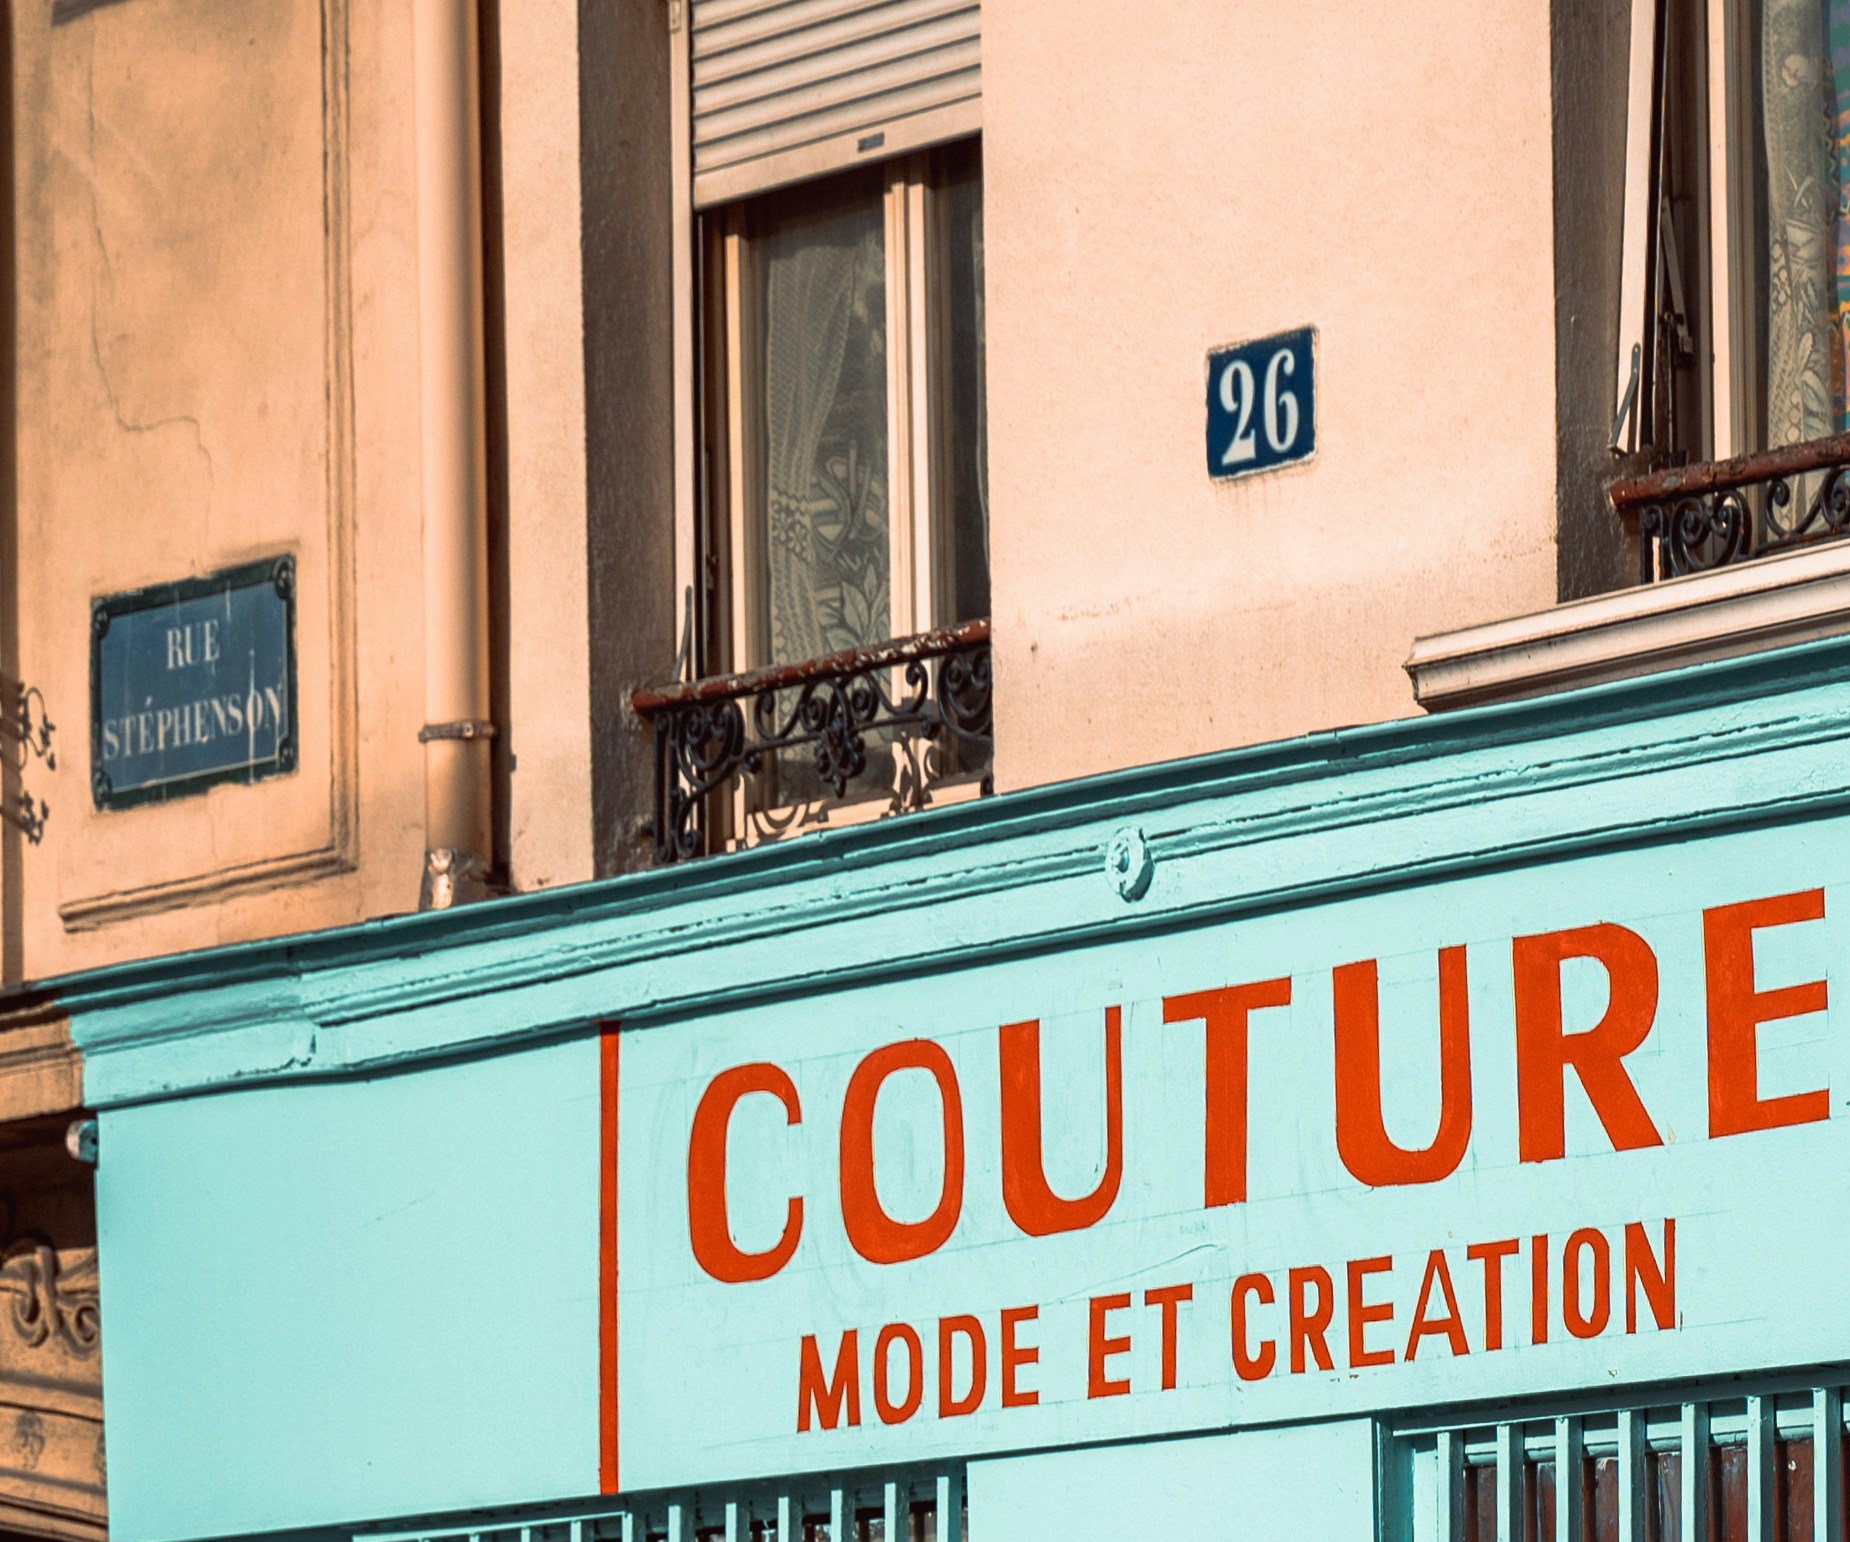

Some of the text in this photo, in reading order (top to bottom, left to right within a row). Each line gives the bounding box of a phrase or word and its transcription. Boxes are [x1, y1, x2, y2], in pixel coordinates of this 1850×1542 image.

[1219, 348, 1299, 467] 26
[165, 619, 221, 671] RUE
[103, 683, 284, 761] STÉPHENSON
[687, 887, 1831, 1285] COUTURE
[798, 1218, 1679, 1434] MODE ET CREATION
